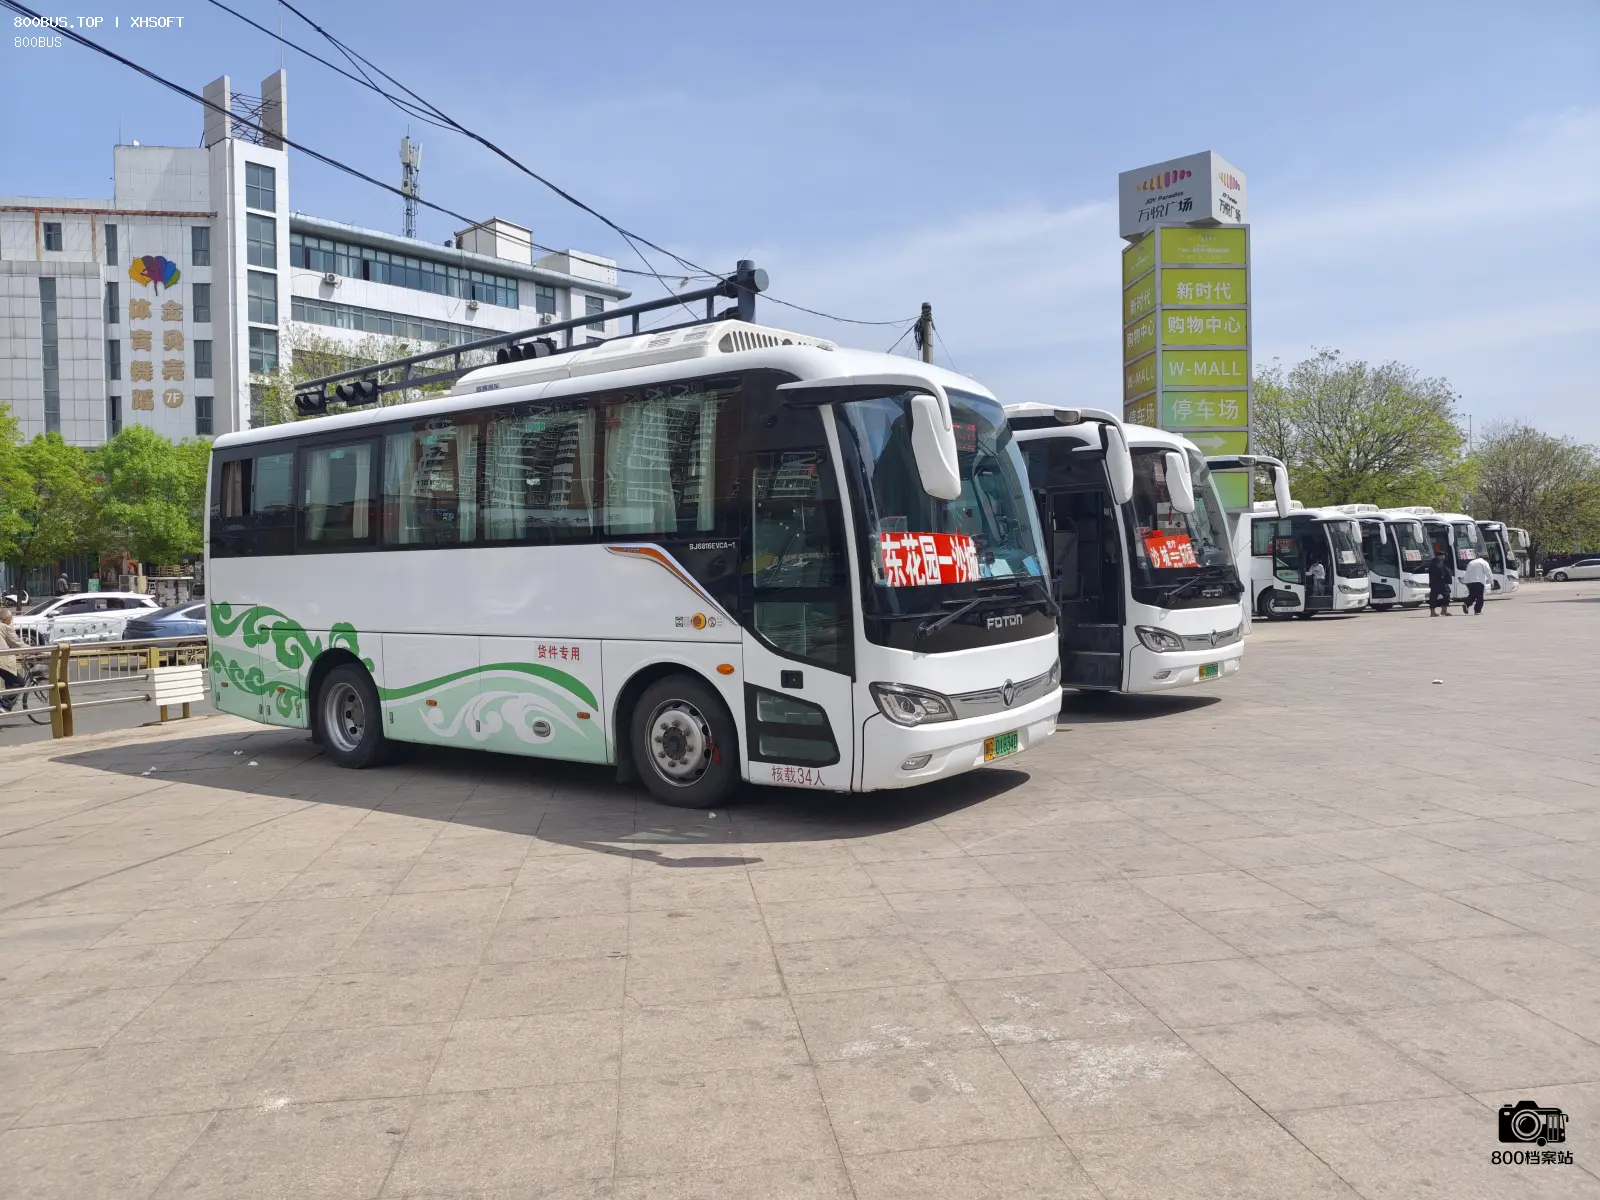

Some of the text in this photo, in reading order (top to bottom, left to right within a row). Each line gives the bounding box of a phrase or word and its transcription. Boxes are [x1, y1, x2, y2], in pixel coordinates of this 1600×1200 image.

[1138, 197, 1194, 223] 万悦广场
[1176, 281, 1232, 300] 新时代
[1129, 288, 1151, 317] 新时代
[1126, 319, 1155, 349] 购物中心
[1167, 315, 1241, 334] 购物中心
[161, 299, 185, 381] 金贝壳
[1169, 361, 1242, 376] W-MALL
[165, 393, 180, 405] 7F
[1171, 398, 1239, 421] 停车场
[1128, 402, 1155, 425] 停车场
[986, 613, 1023, 630] FOTON
[537, 644, 580, 661] 货件专用
[771, 764, 826, 787] 核载34人
